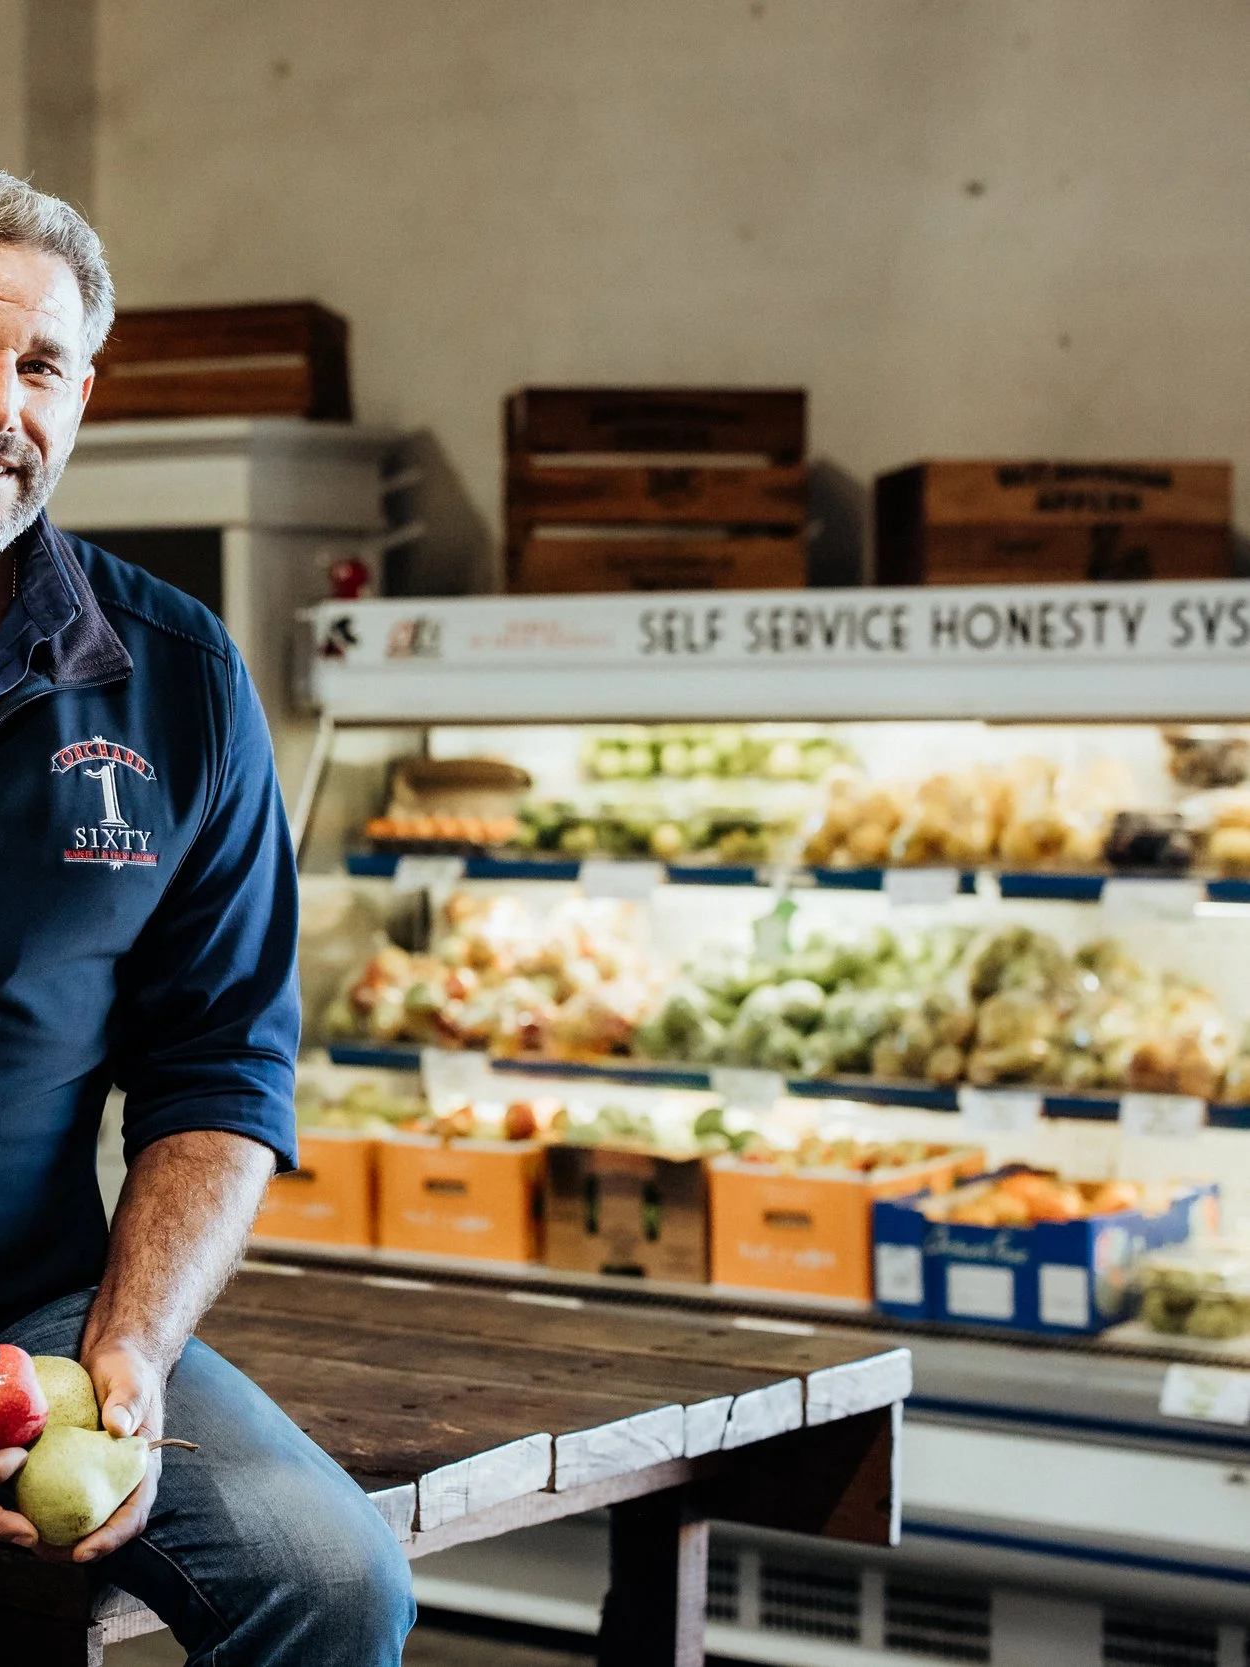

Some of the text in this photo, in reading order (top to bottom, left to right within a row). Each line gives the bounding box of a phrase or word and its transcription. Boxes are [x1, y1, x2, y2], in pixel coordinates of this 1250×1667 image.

[639, 606, 722, 654] SELF
[744, 604, 906, 653] SERVICE
[930, 600, 1146, 650] HONESTY
[1170, 597, 1250, 648] SYS
[60, 742, 146, 773] ORCHARD
[83, 763, 130, 828] 1
[75, 826, 151, 852] SIXTY
